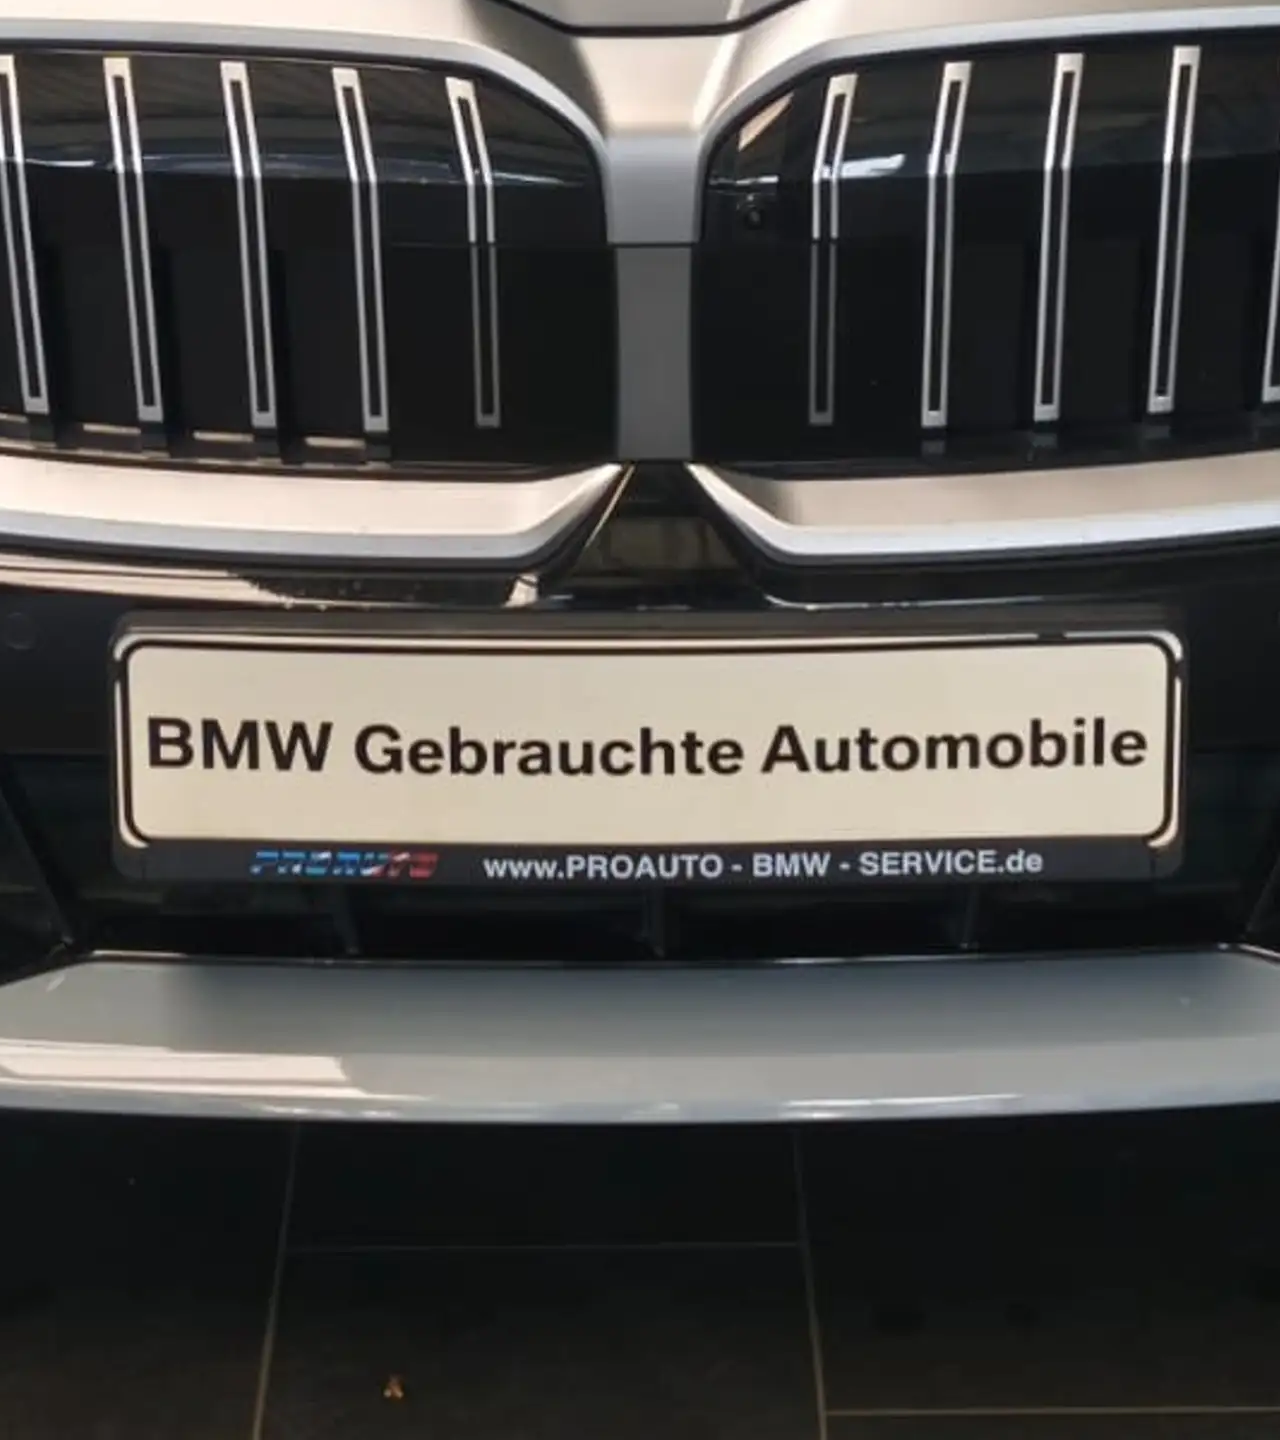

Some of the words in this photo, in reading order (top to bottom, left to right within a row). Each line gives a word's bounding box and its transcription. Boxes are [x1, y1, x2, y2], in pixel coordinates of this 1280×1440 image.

[147, 716, 333, 771] BMW
[354, 723, 743, 775] Gebrauchte
[760, 716, 1147, 772] Automobile
[482, 854, 723, 879] www.PROAUTO
[752, 853, 830, 878] BMW
[858, 849, 1044, 875] SERVICE.de
